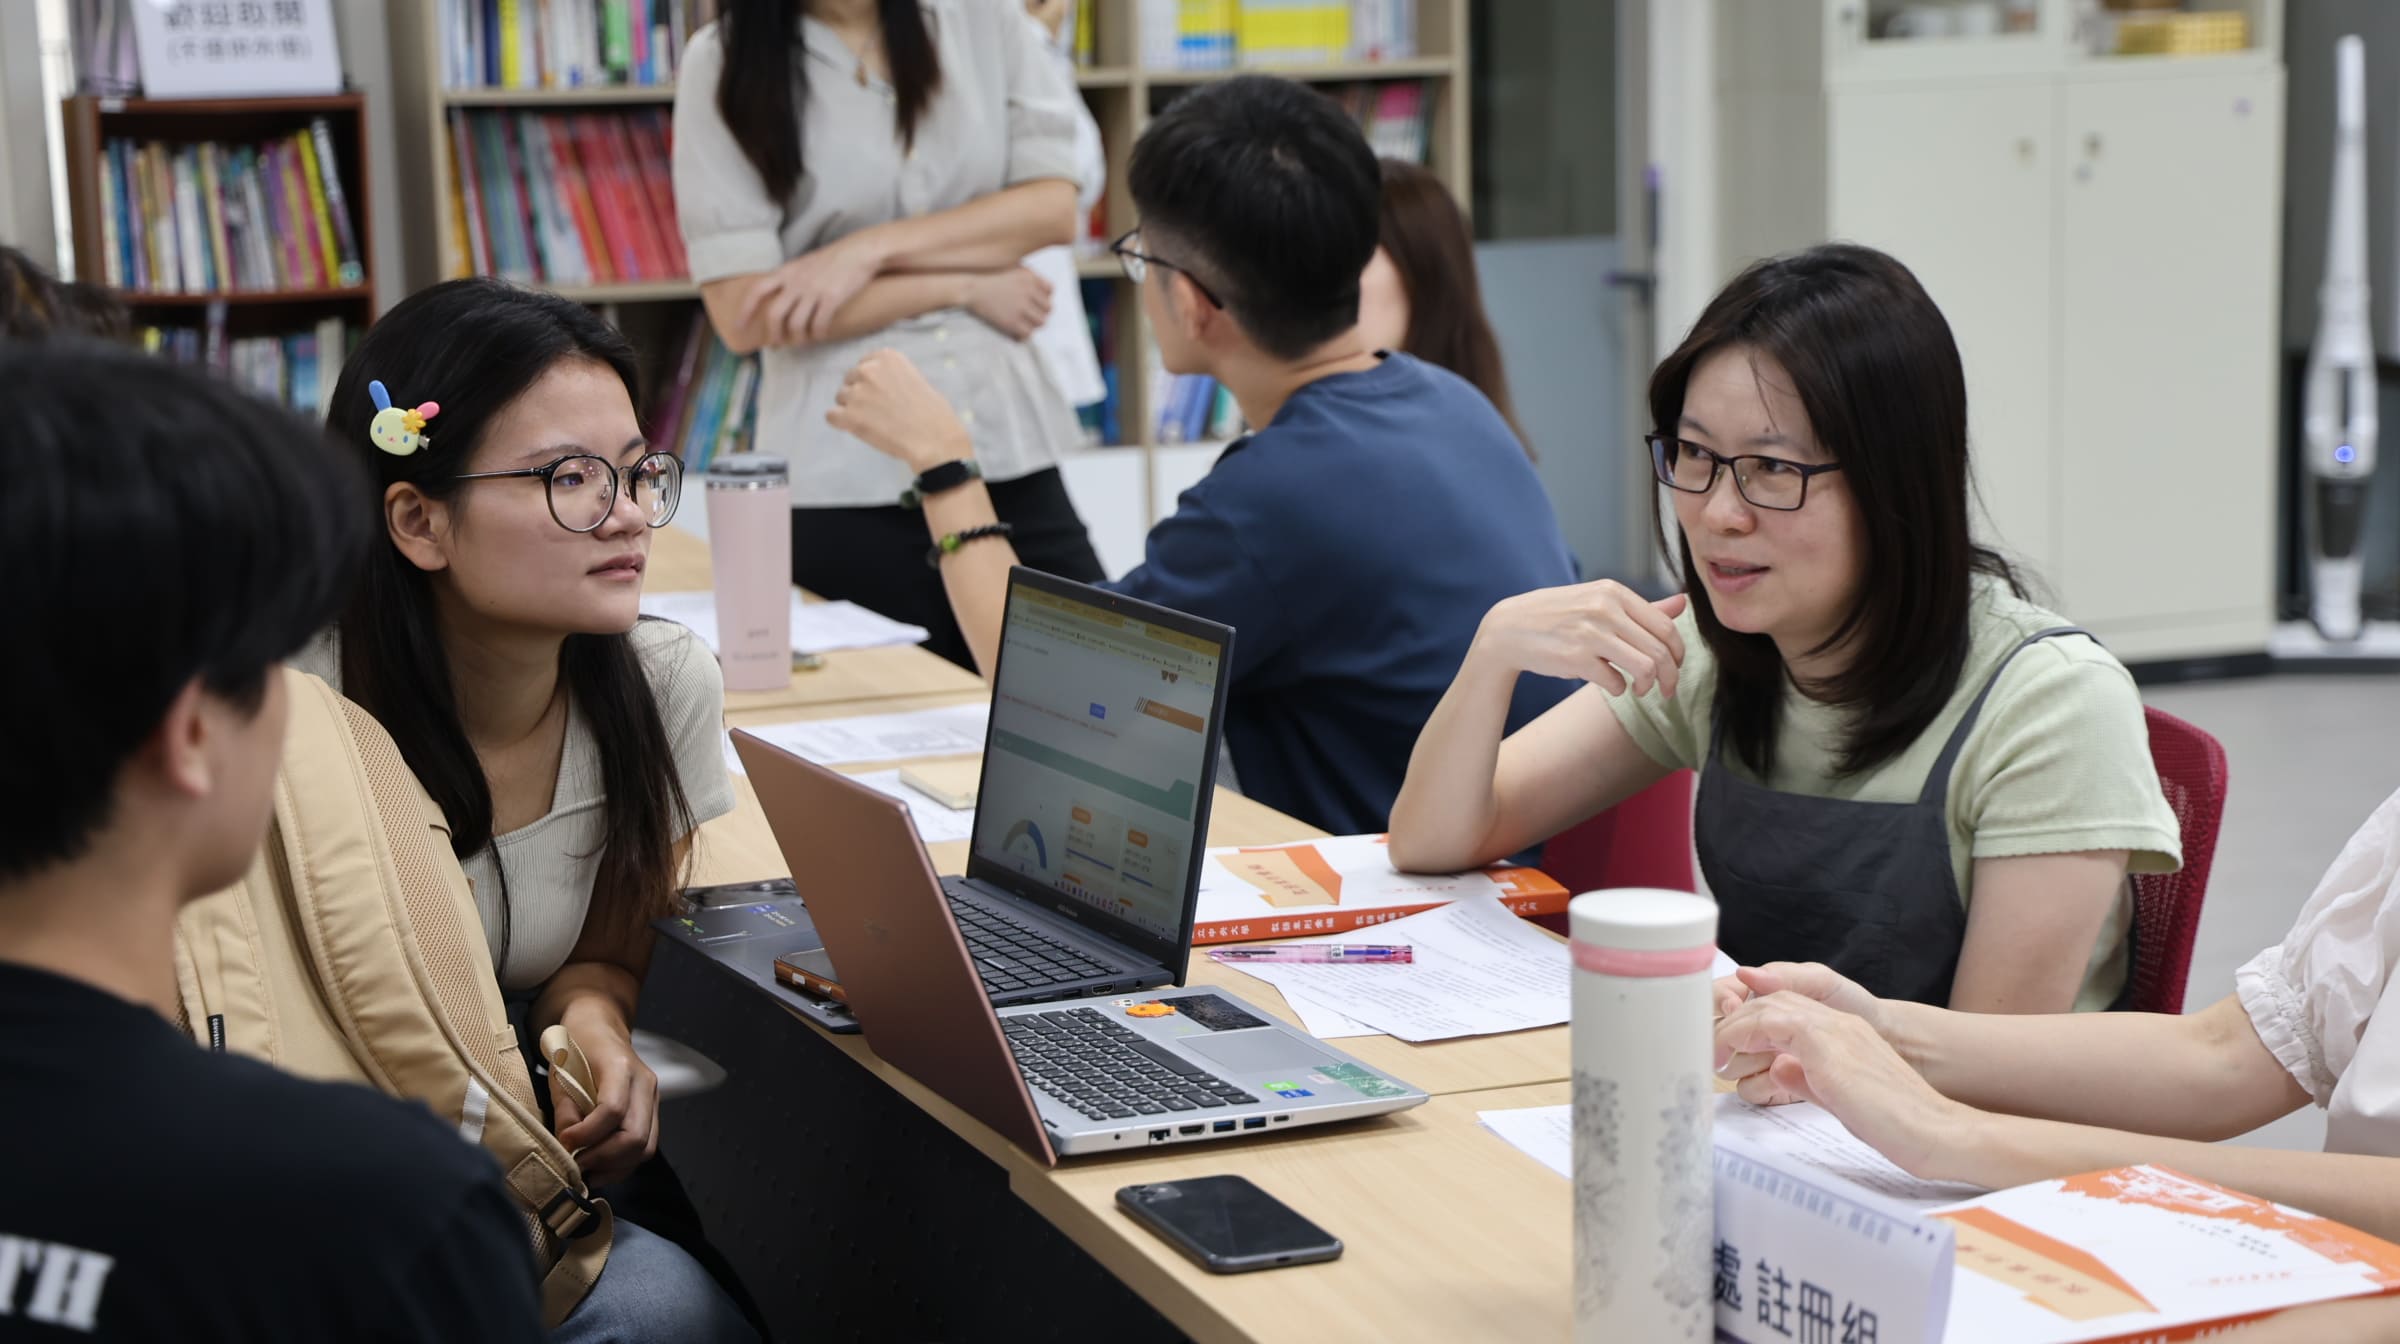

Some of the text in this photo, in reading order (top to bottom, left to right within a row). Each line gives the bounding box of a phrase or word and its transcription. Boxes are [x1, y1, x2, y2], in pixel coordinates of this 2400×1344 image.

[1191, 924, 1250, 940] 立中央大學
